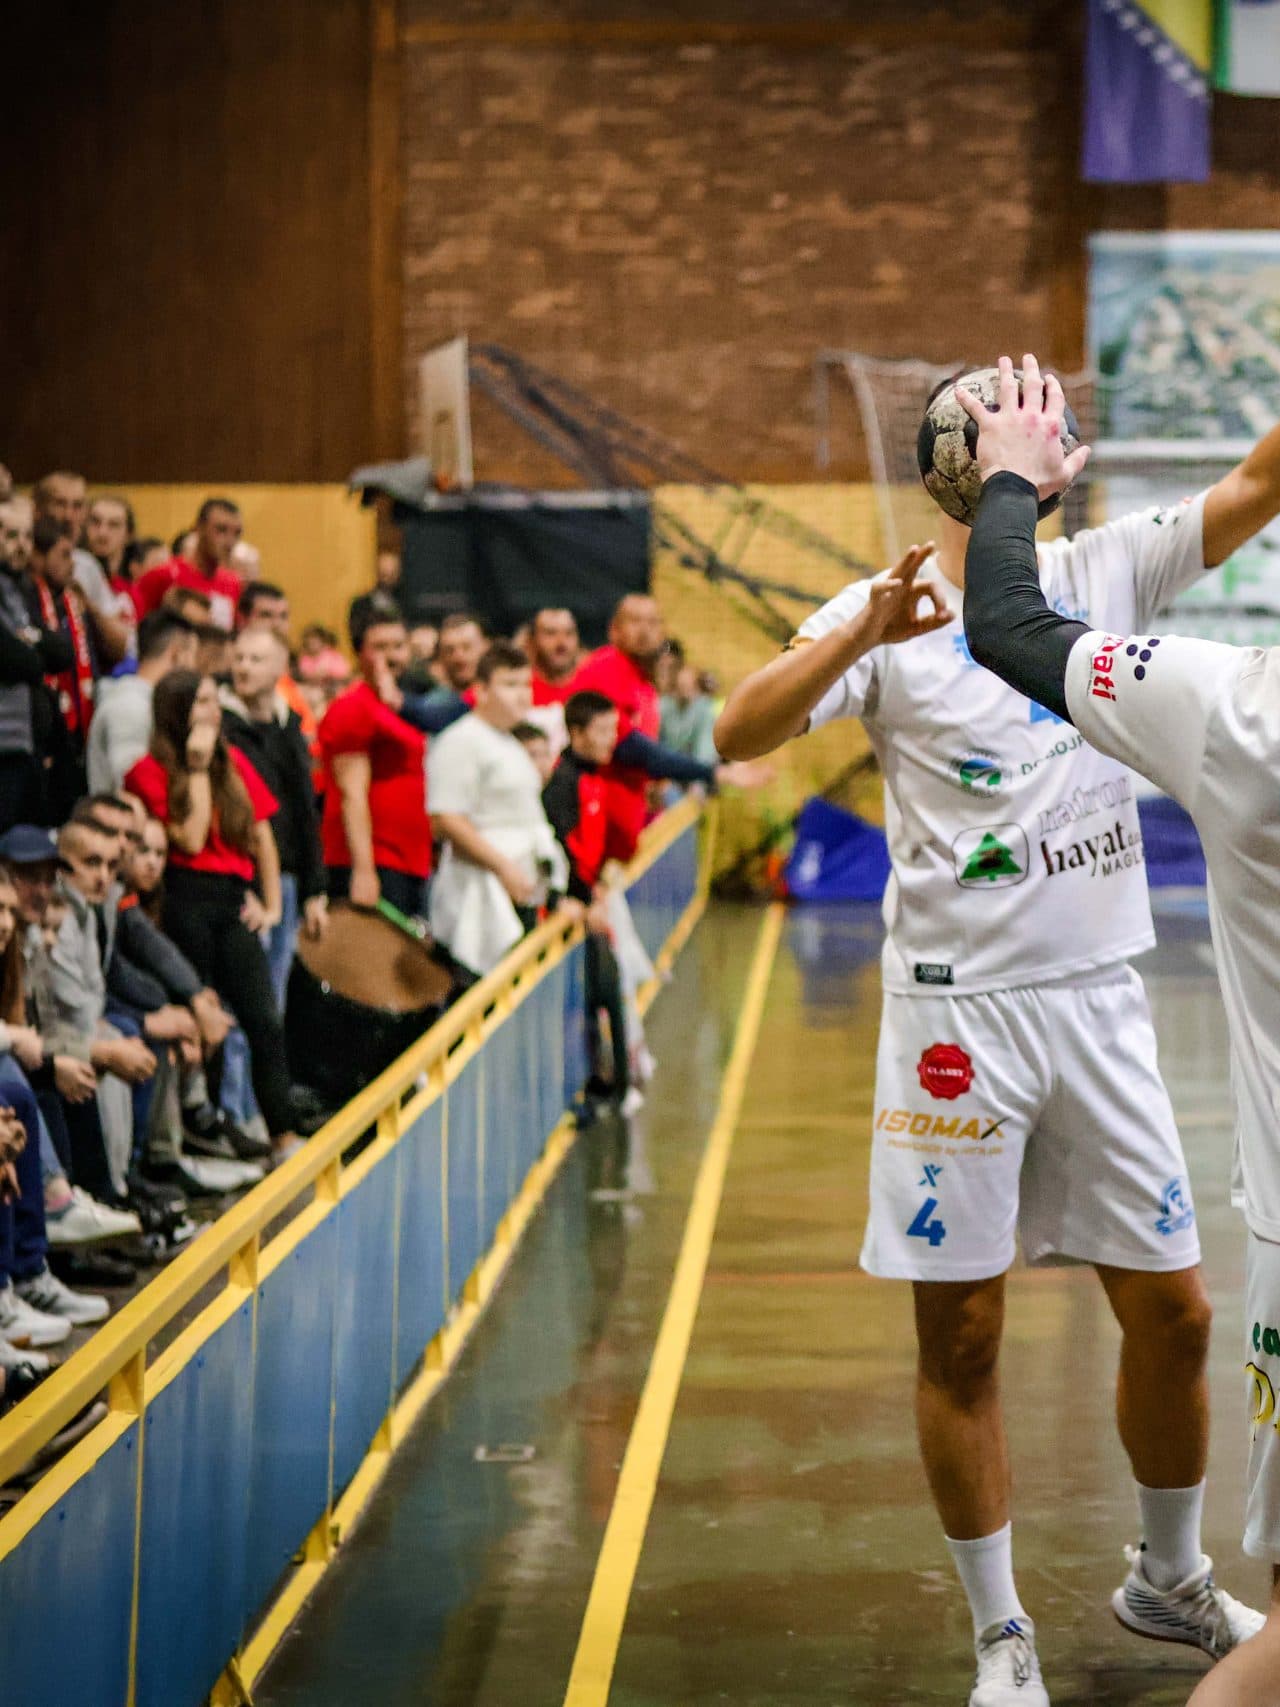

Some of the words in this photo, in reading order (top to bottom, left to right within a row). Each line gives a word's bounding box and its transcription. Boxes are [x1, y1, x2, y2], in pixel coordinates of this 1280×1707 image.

[1040, 820, 1126, 877] hayat
[876, 1108, 1010, 1141] ISOMAX
[906, 1196, 946, 1247] 4
